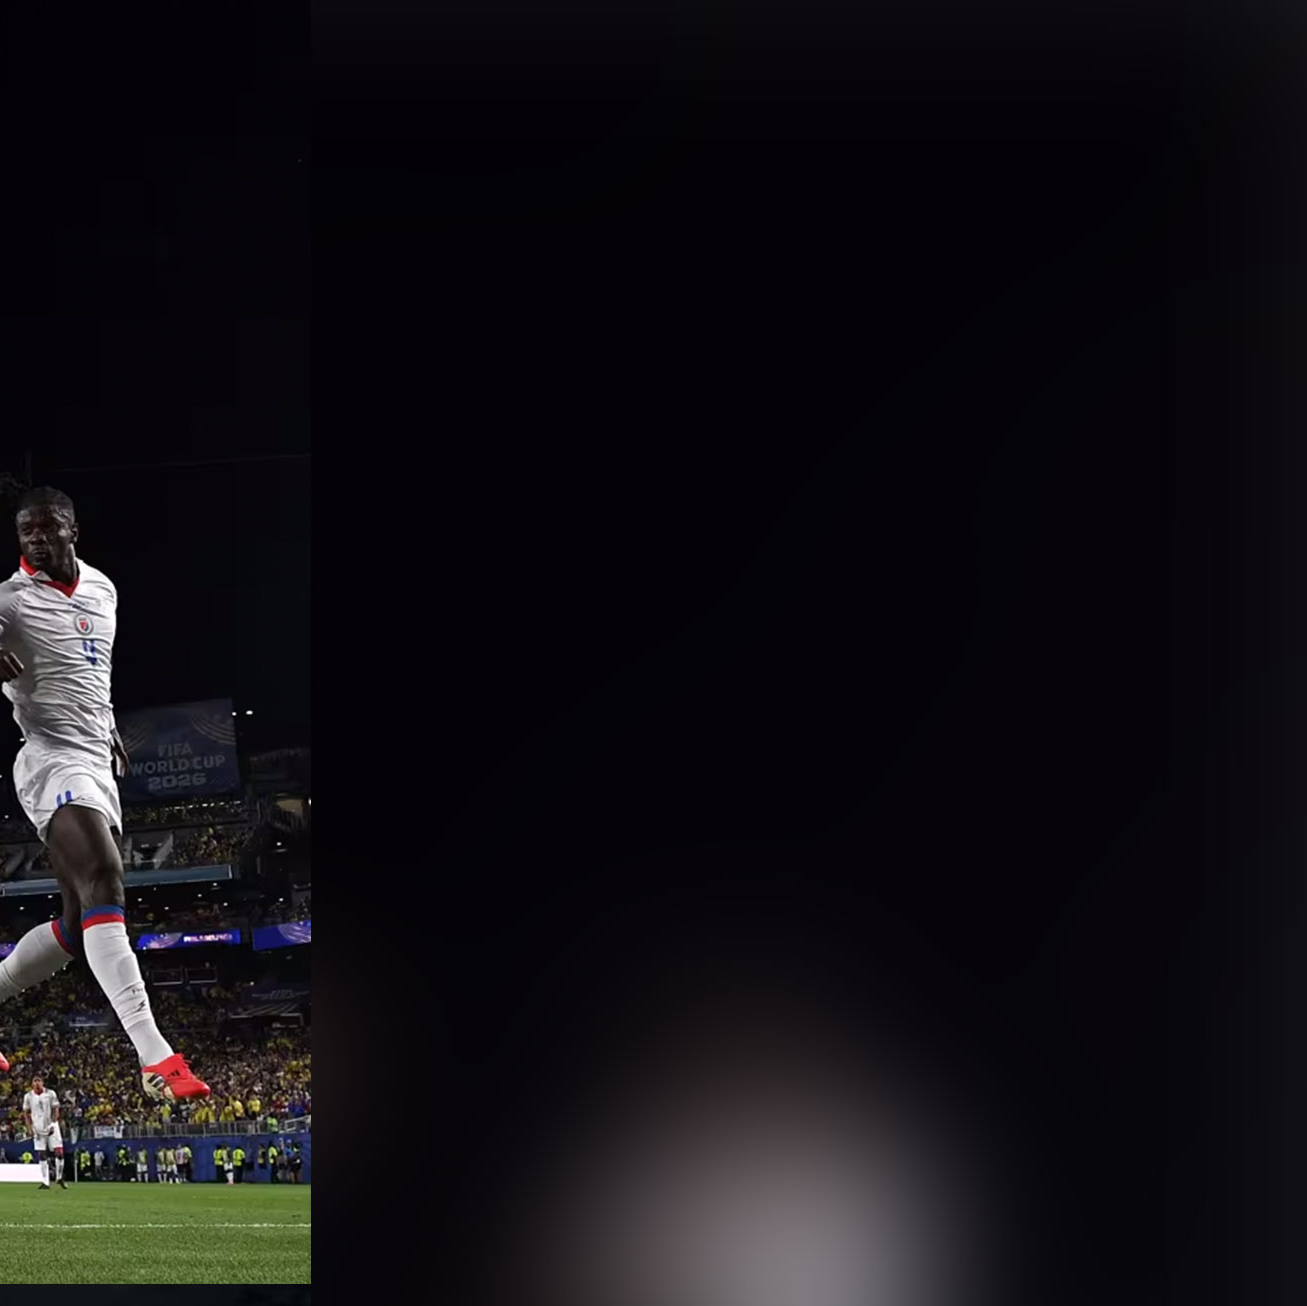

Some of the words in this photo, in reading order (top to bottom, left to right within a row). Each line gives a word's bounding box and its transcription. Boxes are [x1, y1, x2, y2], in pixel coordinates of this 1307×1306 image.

[157, 743, 193, 757] FIFA
[130, 759, 190, 776] WORLD
[193, 755, 226, 770] CUP
[147, 773, 207, 790] 2026
